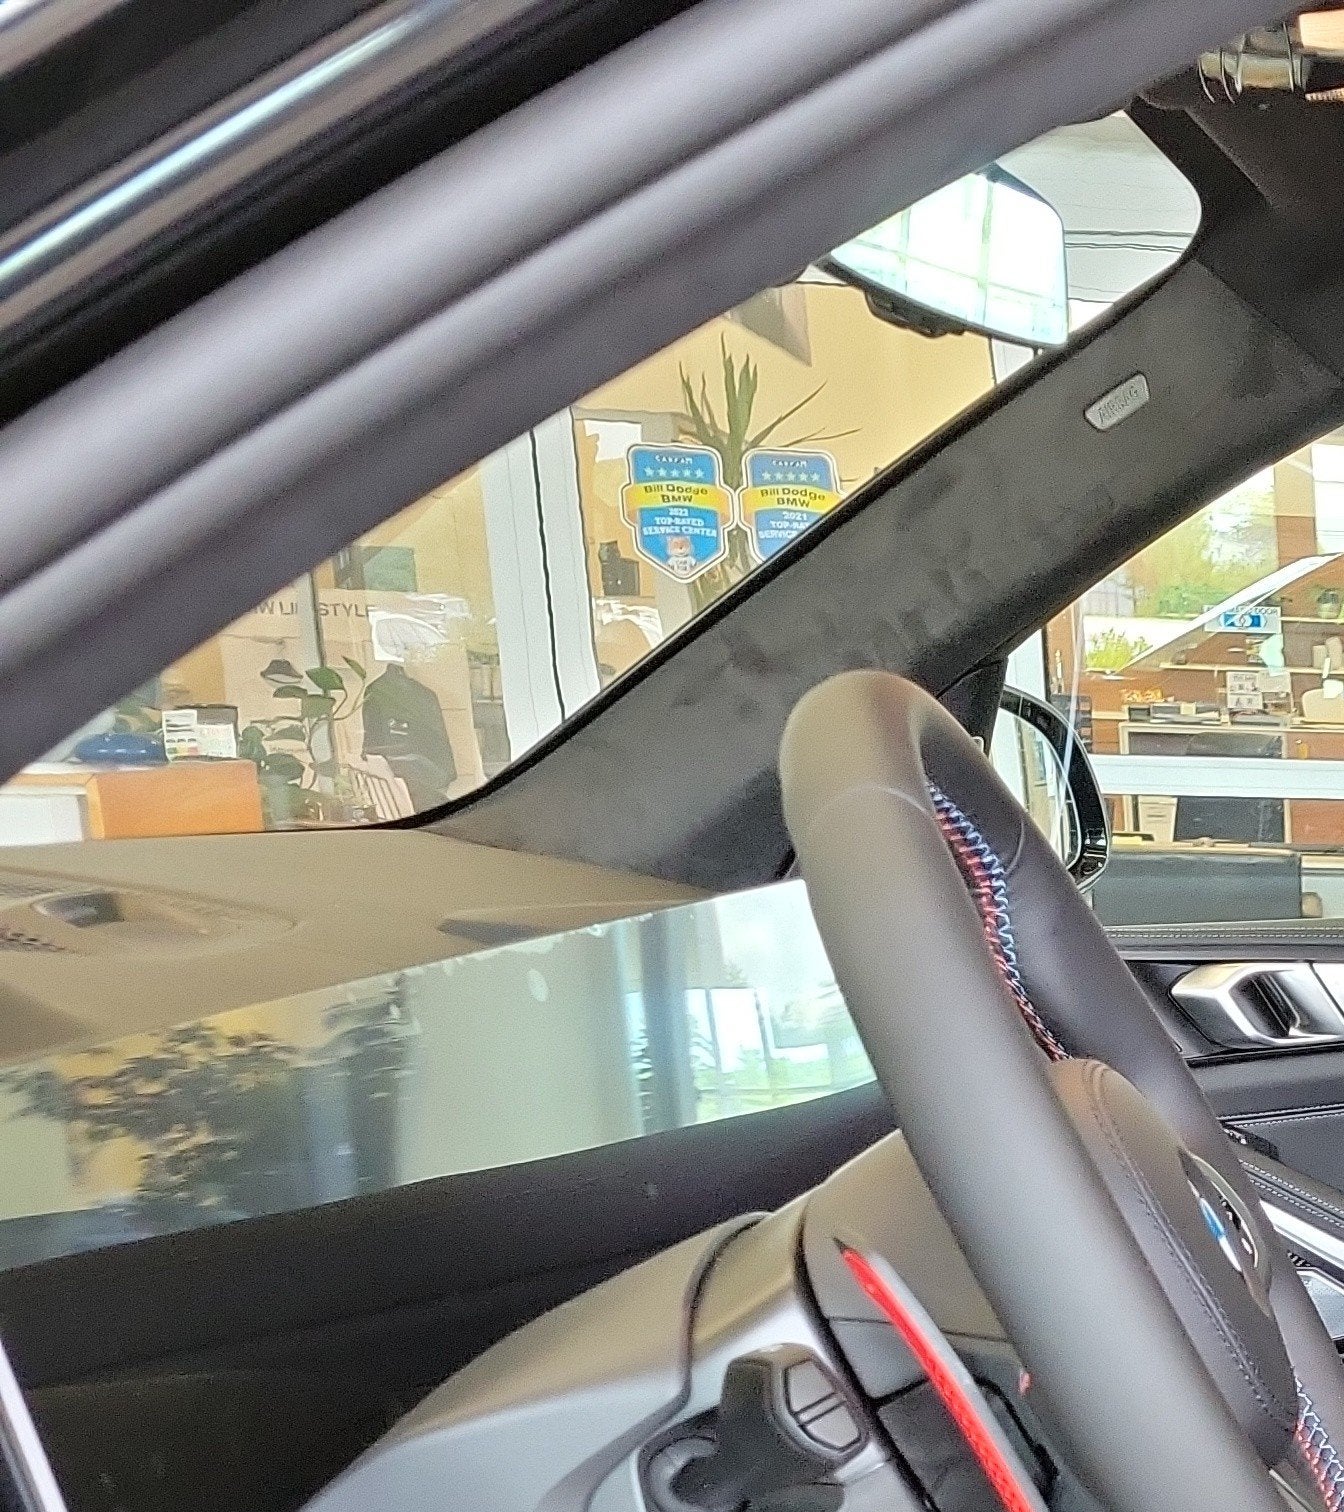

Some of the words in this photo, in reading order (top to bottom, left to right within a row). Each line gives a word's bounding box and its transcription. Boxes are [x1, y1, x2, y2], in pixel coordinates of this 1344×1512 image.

[644, 484, 663, 493] Bill
[666, 483, 708, 495] Dodge
[760, 488, 779, 498] Bill
[782, 487, 826, 501] Dodge
[661, 494, 693, 503] BMW
[776, 497, 811, 508] BMW
[782, 511, 808, 520] 2021
